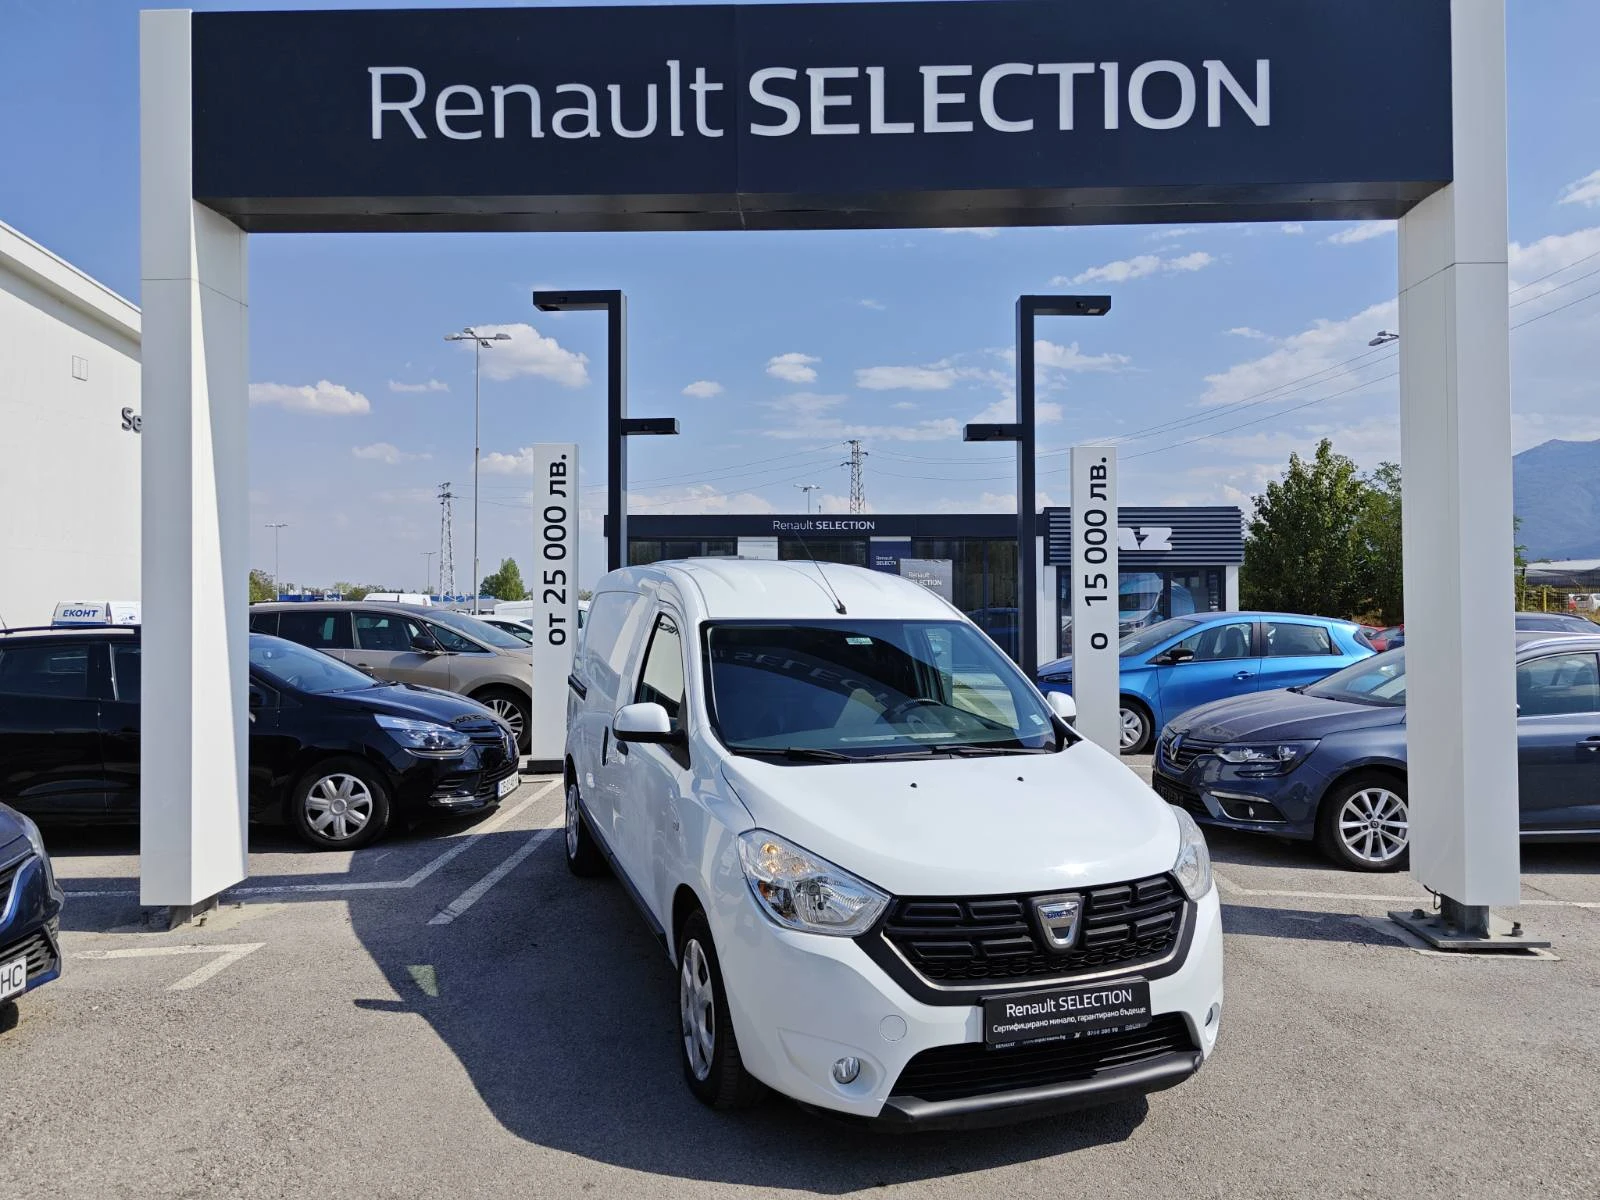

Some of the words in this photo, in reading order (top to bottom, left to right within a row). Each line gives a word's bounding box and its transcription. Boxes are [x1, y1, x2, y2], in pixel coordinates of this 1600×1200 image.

[367, 59, 724, 140] Renault
[748, 58, 1271, 137] SELECTION
[549, 454, 567, 498] лв.
[1090, 457, 1108, 501] лв.
[543, 505, 567, 561] 000
[773, 519, 813, 531] Renault
[815, 520, 876, 531] SELECTION
[1084, 509, 1108, 564] 000
[543, 569, 567, 605] 25
[1084, 573, 1108, 607] 15
[548, 613, 566, 646] от
[1006, 997, 1056, 1018] Renault
[1059, 988, 1133, 1012] SELECTION
[992, 1018, 1049, 1035] Сертифицирано
[1077, 1009, 1119, 1024] гарантирано
